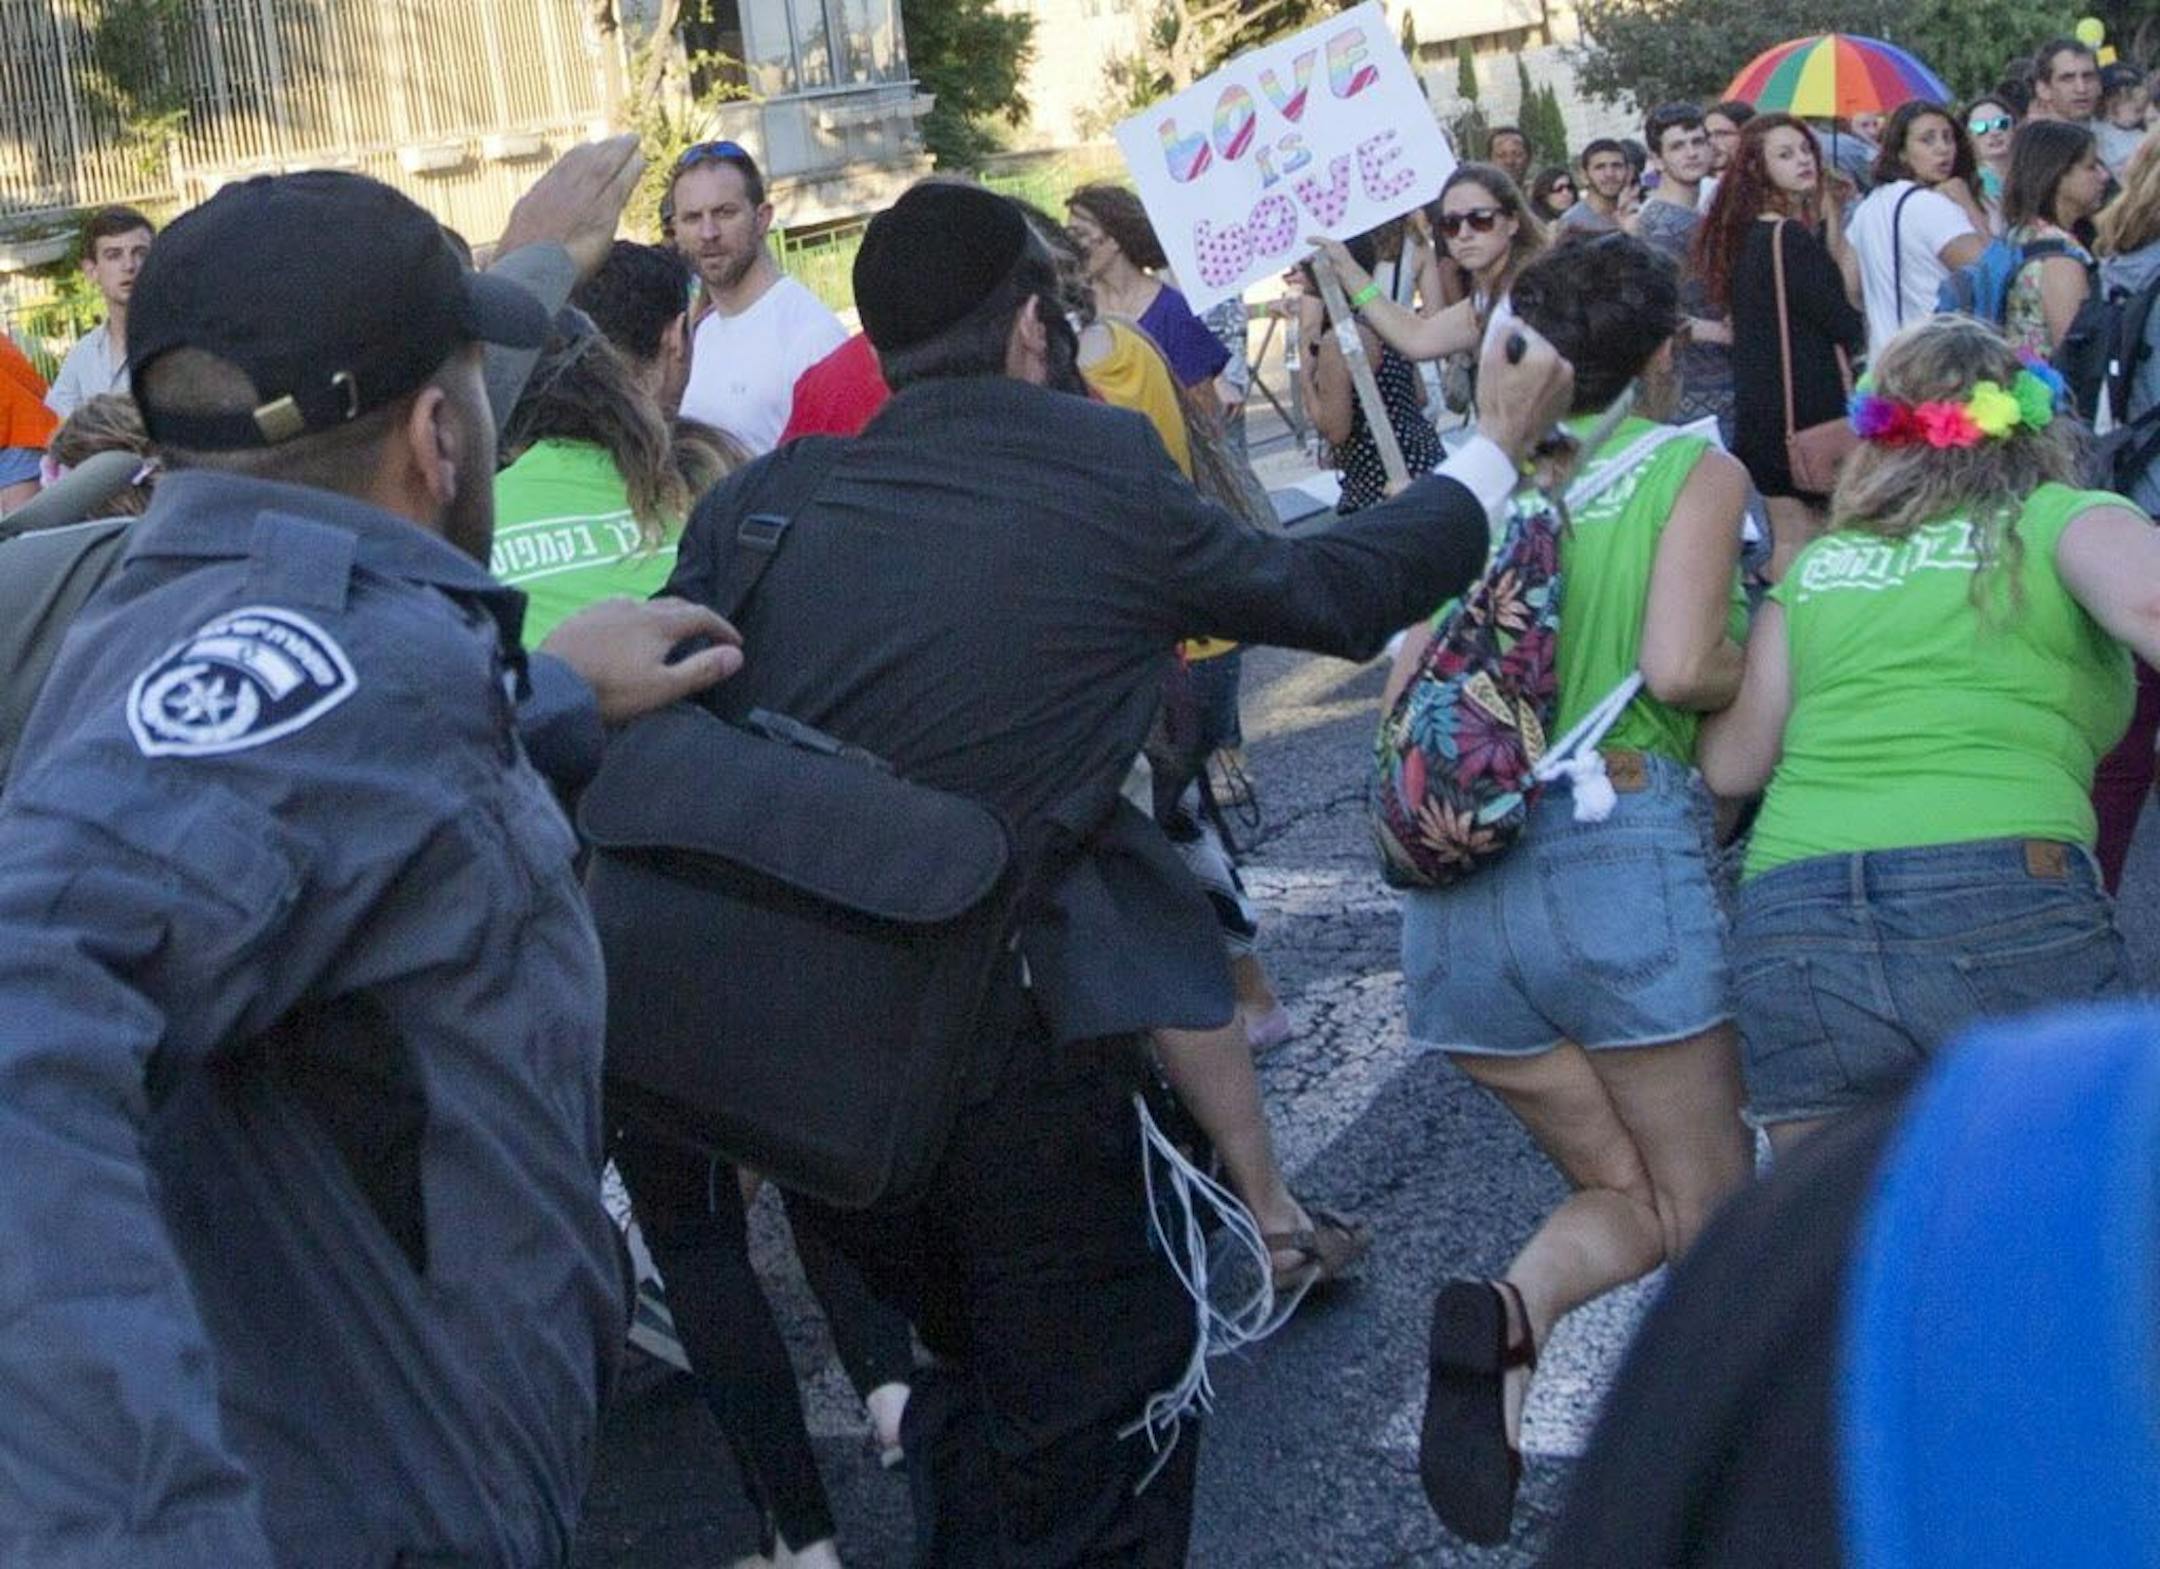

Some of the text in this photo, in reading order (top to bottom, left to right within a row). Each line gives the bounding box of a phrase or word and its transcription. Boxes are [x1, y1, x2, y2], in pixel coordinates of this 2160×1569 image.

[1156, 26, 1379, 184] LOVE
[1254, 132, 1312, 190] IS
[1193, 129, 1417, 289] LOVE
